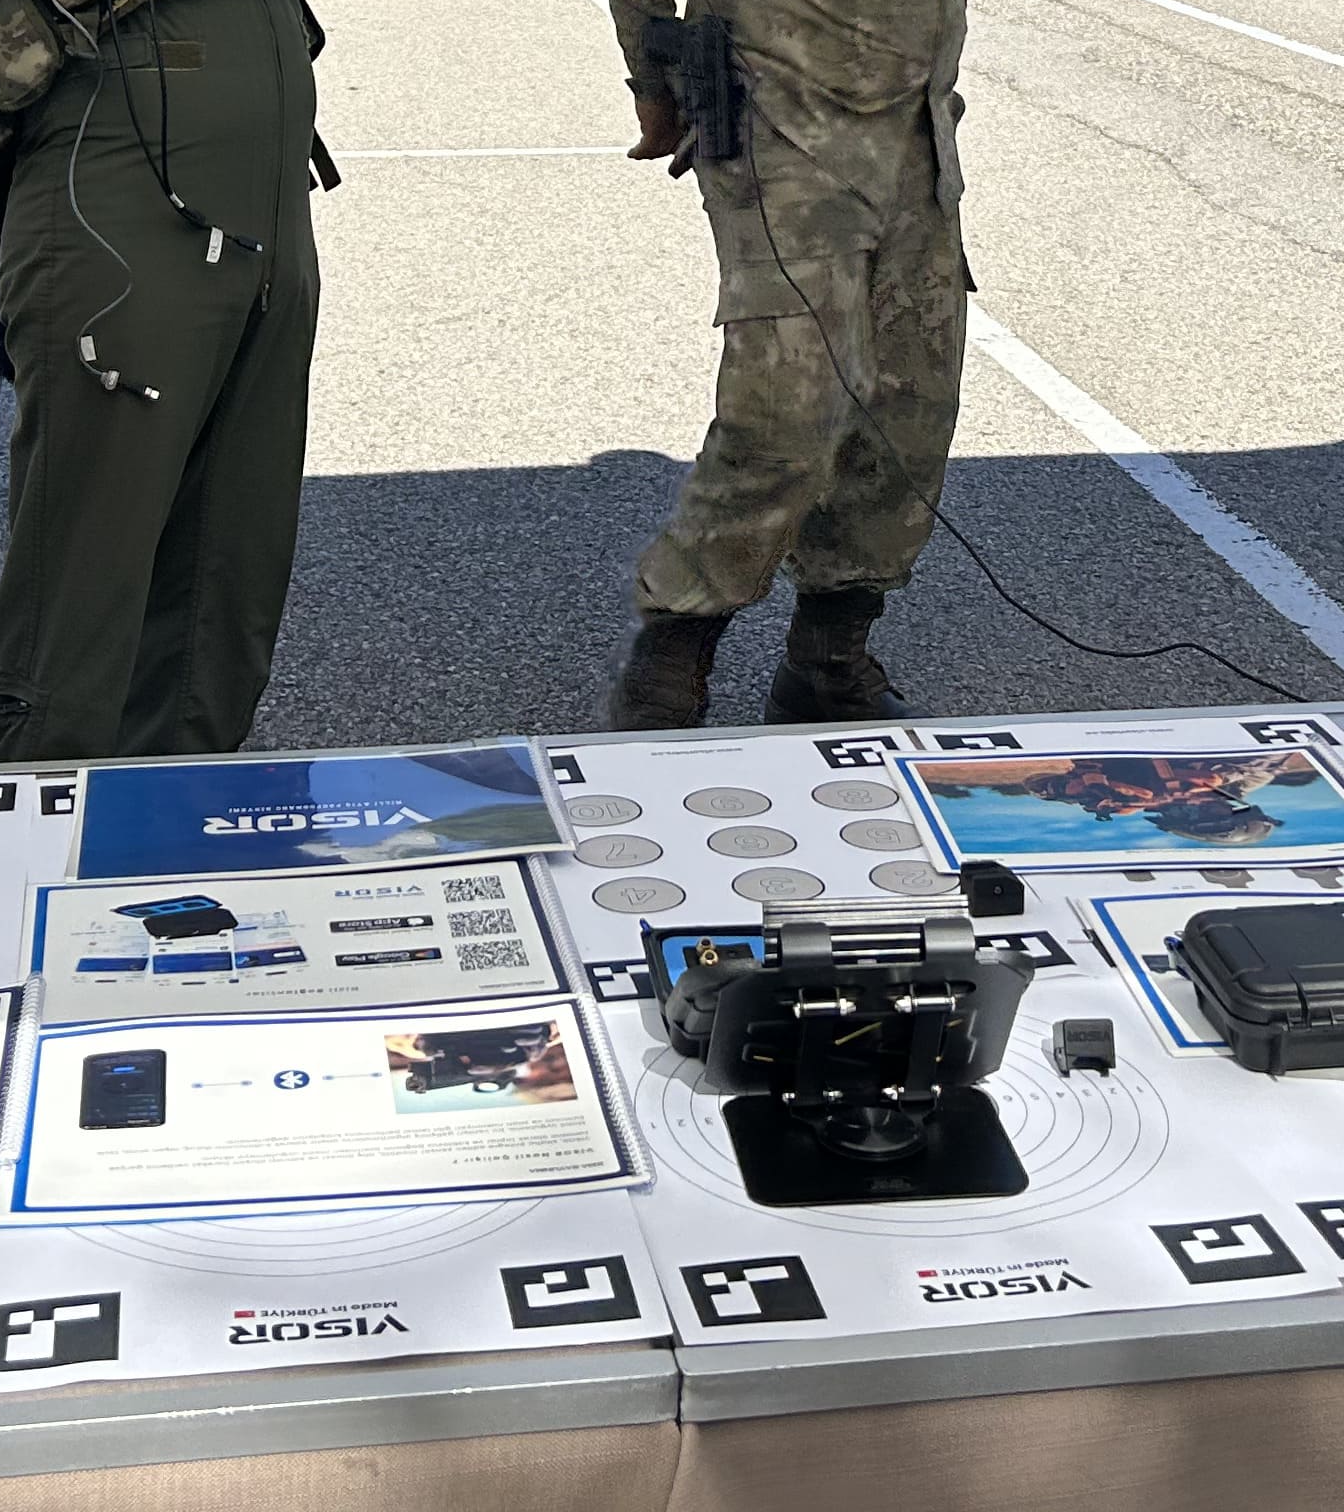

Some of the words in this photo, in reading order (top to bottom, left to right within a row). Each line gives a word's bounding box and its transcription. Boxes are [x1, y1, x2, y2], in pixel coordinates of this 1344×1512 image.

[710, 794, 746, 812] 9
[837, 787, 873, 805] 8
[202, 806, 433, 835] VISOR
[569, 802, 631, 821] 10
[734, 833, 770, 852] 6
[866, 827, 902, 845] 5
[602, 842, 638, 862] 7
[759, 876, 797, 896] 3
[894, 869, 934, 889] 2
[335, 884, 422, 899] VISOR
[620, 886, 658, 906] 4
[941, 1266, 1005, 1277] TÜRKİYE
[1024, 1257, 1069, 1269] Made
[918, 1270, 1093, 1304] VISOR
[260, 1308, 328, 1319] TÜRKİYE
[351, 1301, 398, 1311] Made
[228, 1313, 409, 1345] VISOR
